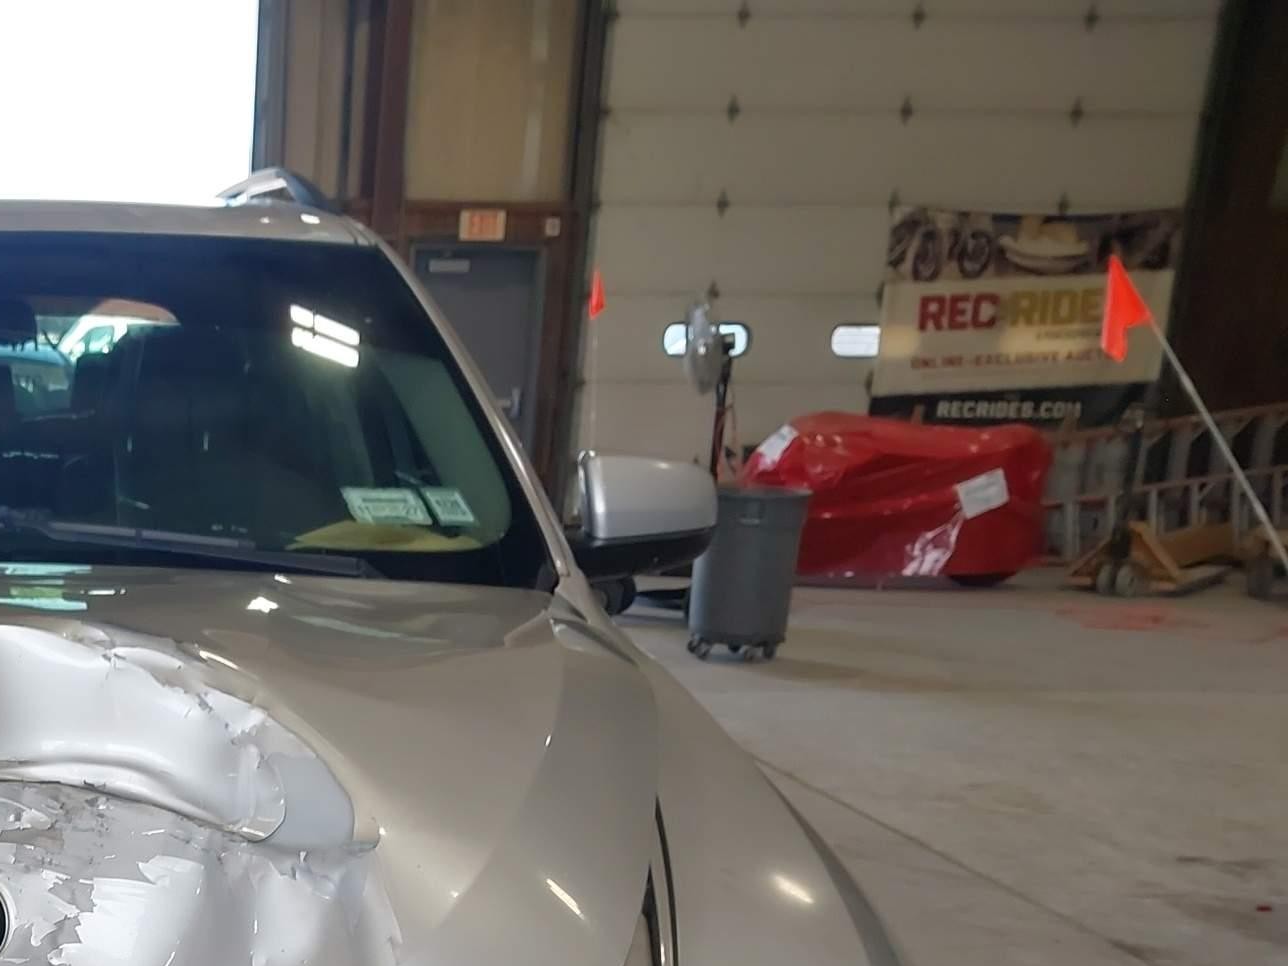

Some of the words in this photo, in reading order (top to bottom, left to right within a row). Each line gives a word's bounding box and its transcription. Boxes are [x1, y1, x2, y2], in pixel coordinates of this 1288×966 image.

[918, 292, 1000, 332] REC
[1010, 288, 1106, 327] RIDE
[936, 401, 1082, 420] RECRIDES.COM
